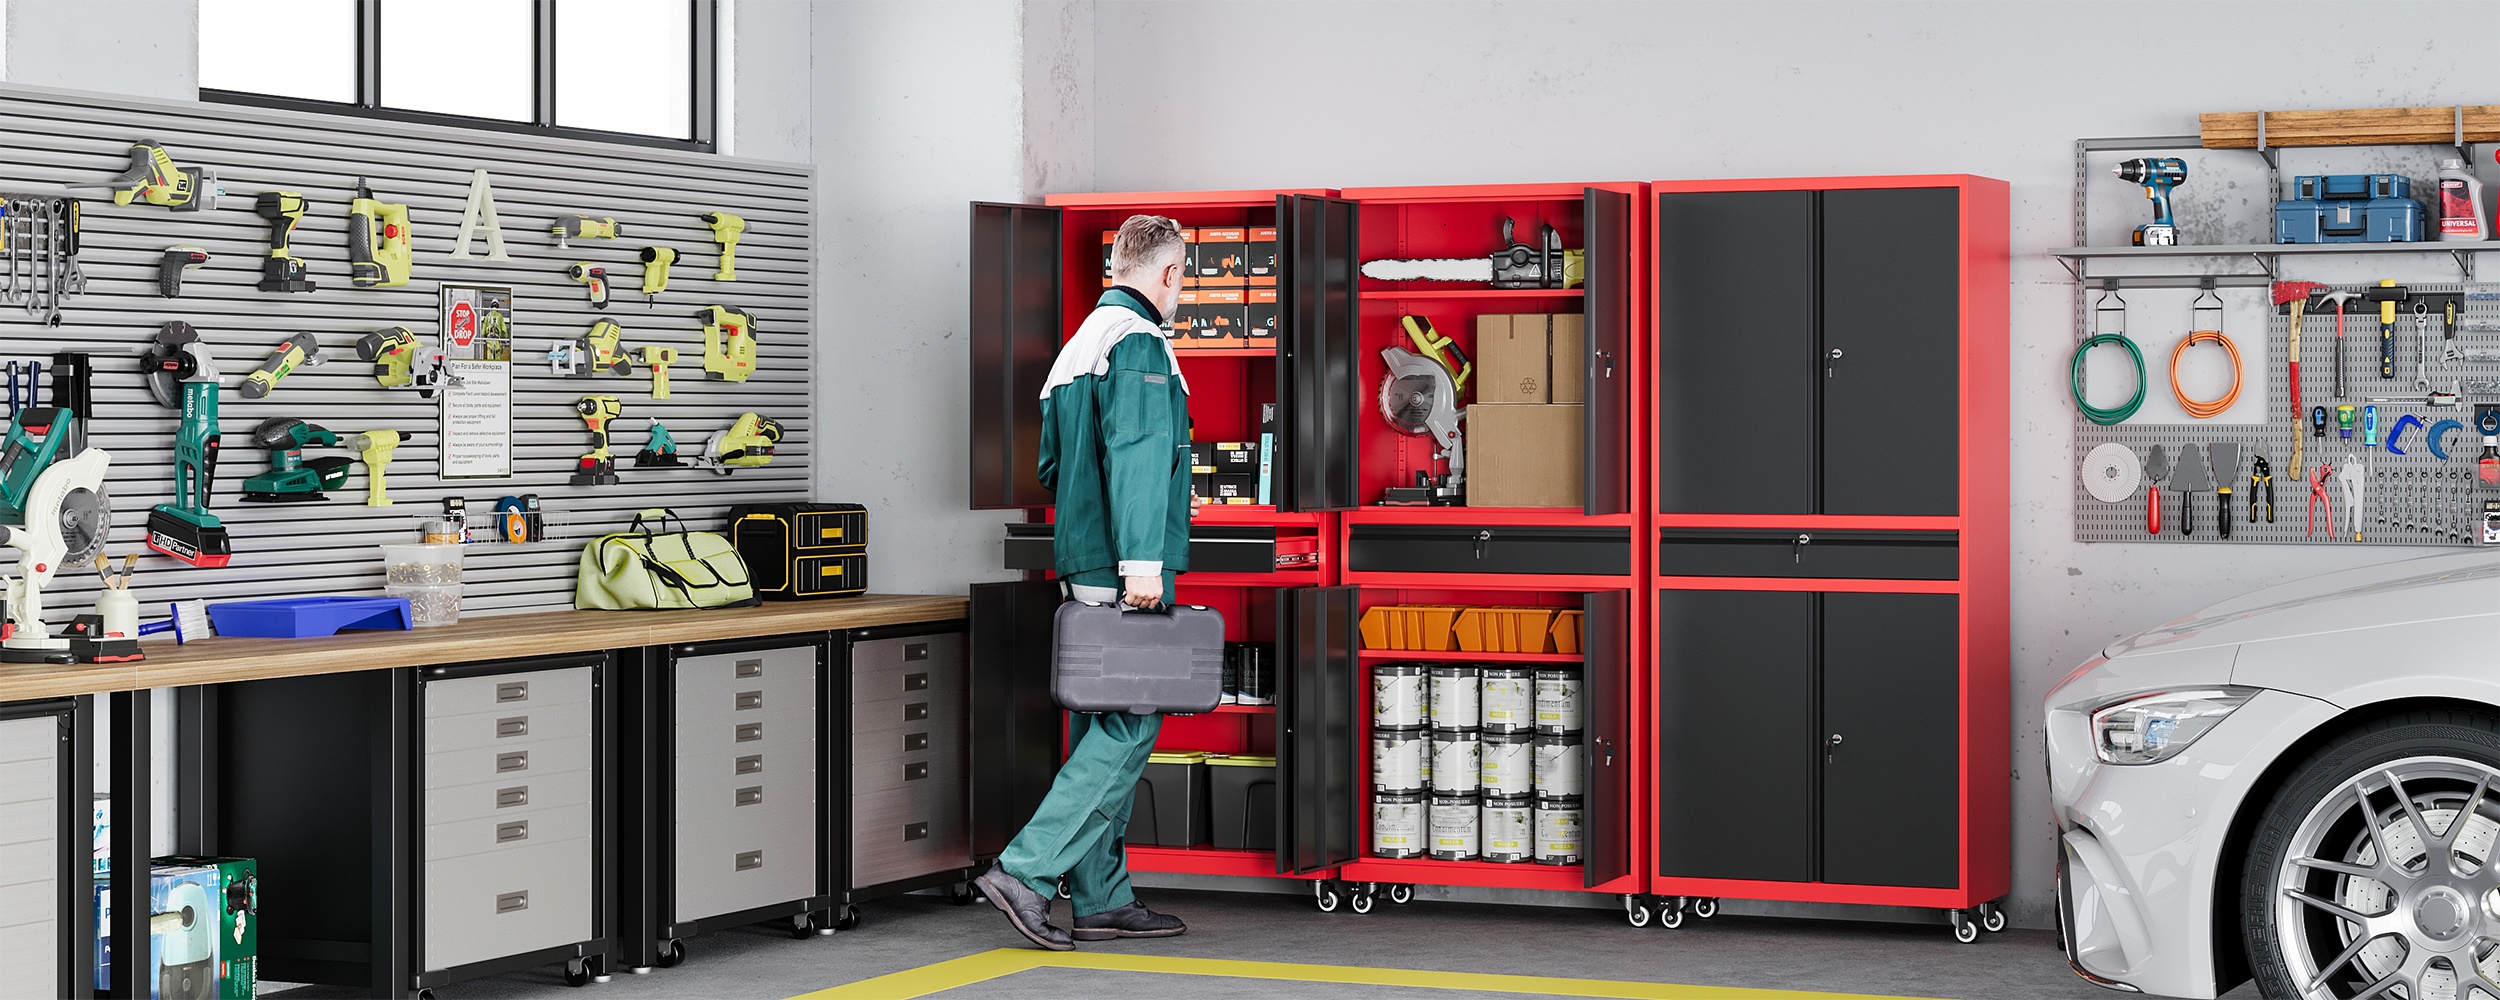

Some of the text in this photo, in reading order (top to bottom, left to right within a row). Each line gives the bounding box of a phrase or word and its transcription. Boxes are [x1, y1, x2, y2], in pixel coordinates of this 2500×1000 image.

[449, 168, 512, 262] A
[456, 309, 471, 319] STOP
[454, 329, 472, 340] DROP
[172, 541, 195, 557] Partner
